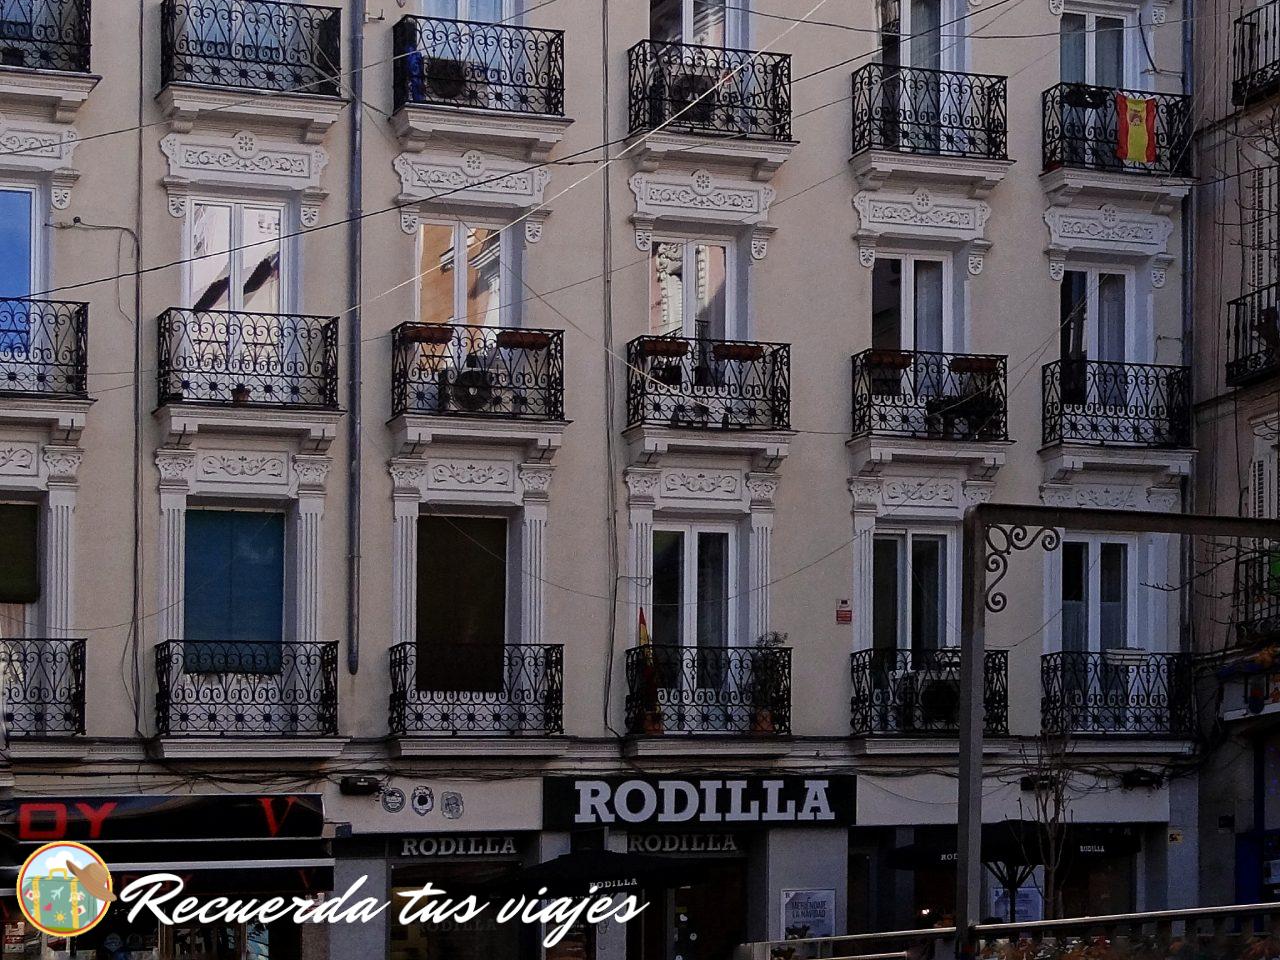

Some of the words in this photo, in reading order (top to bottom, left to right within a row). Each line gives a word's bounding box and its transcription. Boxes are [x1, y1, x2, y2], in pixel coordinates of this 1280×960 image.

[573, 780, 836, 823] RODILLA
[401, 837, 519, 856] RODILLA
[628, 831, 739, 853] RODILLA
